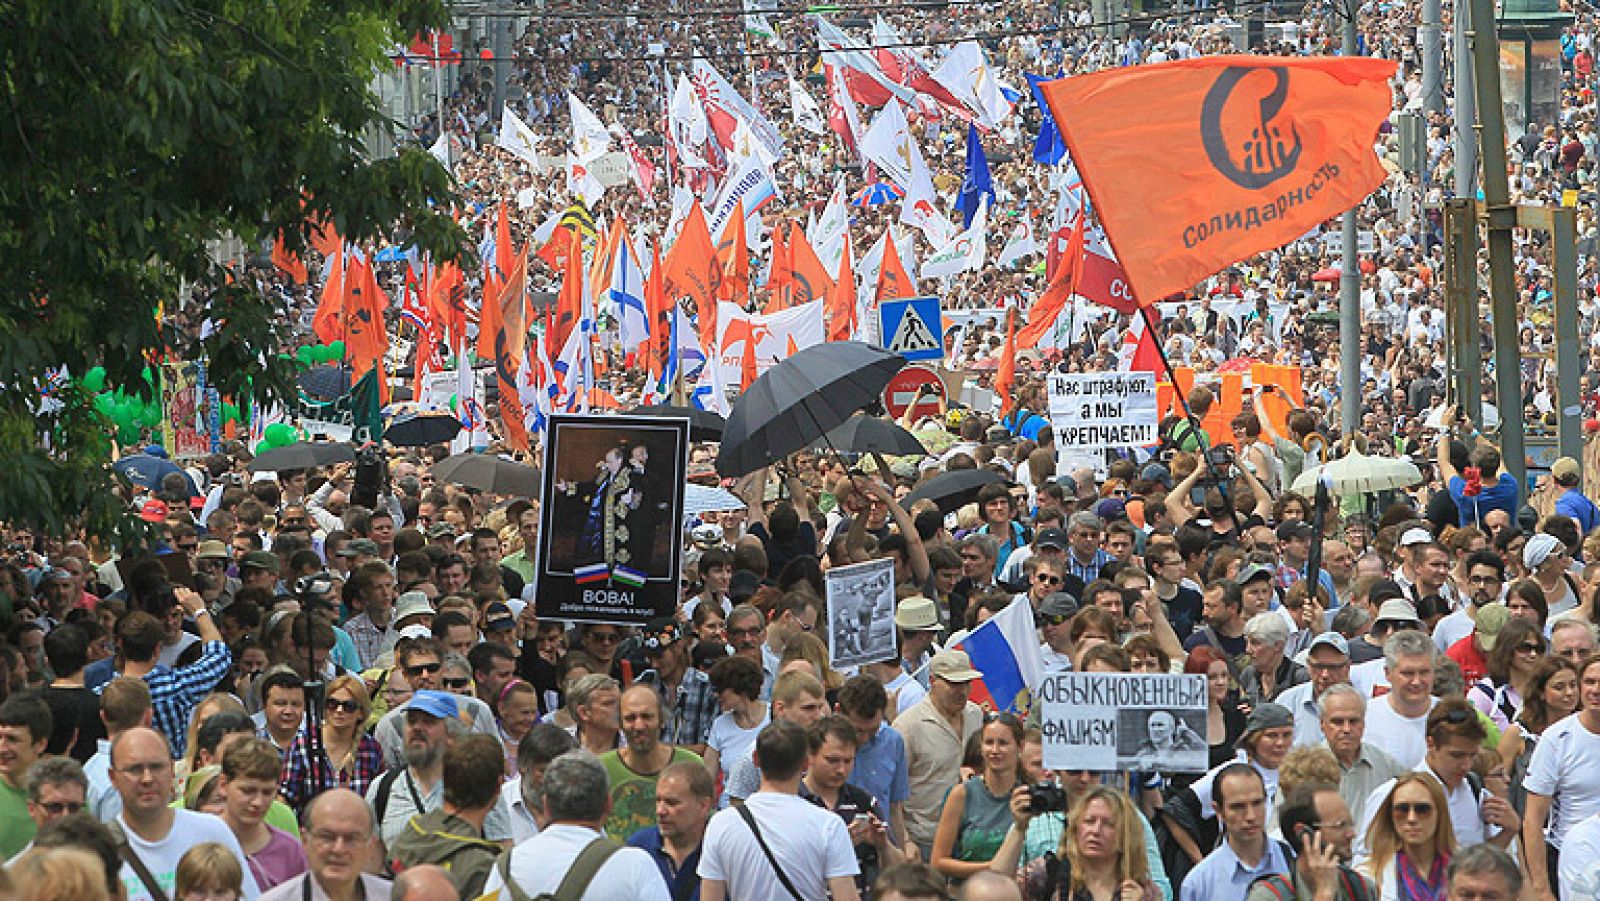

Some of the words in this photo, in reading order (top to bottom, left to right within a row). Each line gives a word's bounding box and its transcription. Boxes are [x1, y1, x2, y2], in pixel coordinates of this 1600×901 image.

[1183, 162, 1340, 248] Солидарность
[1056, 378, 1079, 396] Нас
[1083, 376, 1150, 398] штрафуют,
[1080, 403, 1091, 419] а
[1095, 402, 1122, 417] мы
[1060, 425, 1150, 445] КРЕПЧАЕМ!
[583, 589, 634, 605] ВОВА!
[1042, 675, 1206, 707] ОБЫКНОВЕННЫЙ
[1042, 717, 1116, 747] ФАШИЗМ
